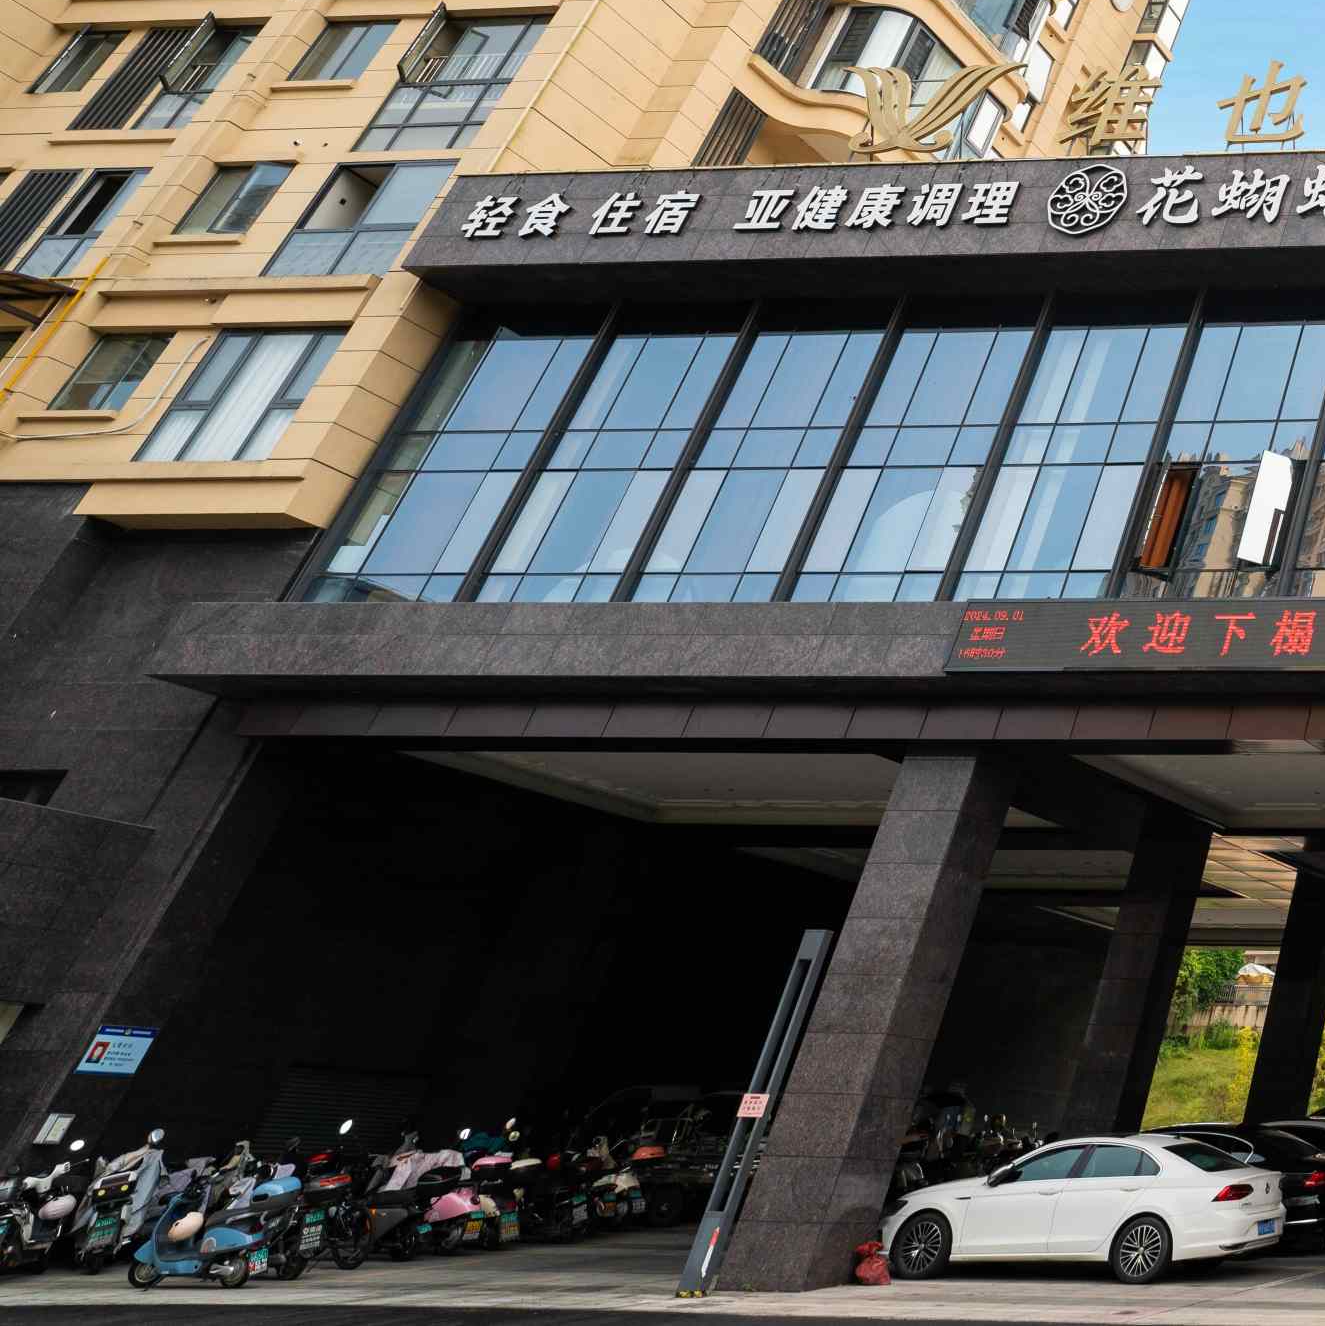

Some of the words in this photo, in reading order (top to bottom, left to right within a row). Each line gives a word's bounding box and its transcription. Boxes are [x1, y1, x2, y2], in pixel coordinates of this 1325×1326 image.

[460, 192, 571, 239] 轻食
[588, 190, 701, 235] 住宿
[732, 181, 1020, 231] 亚健康调理
